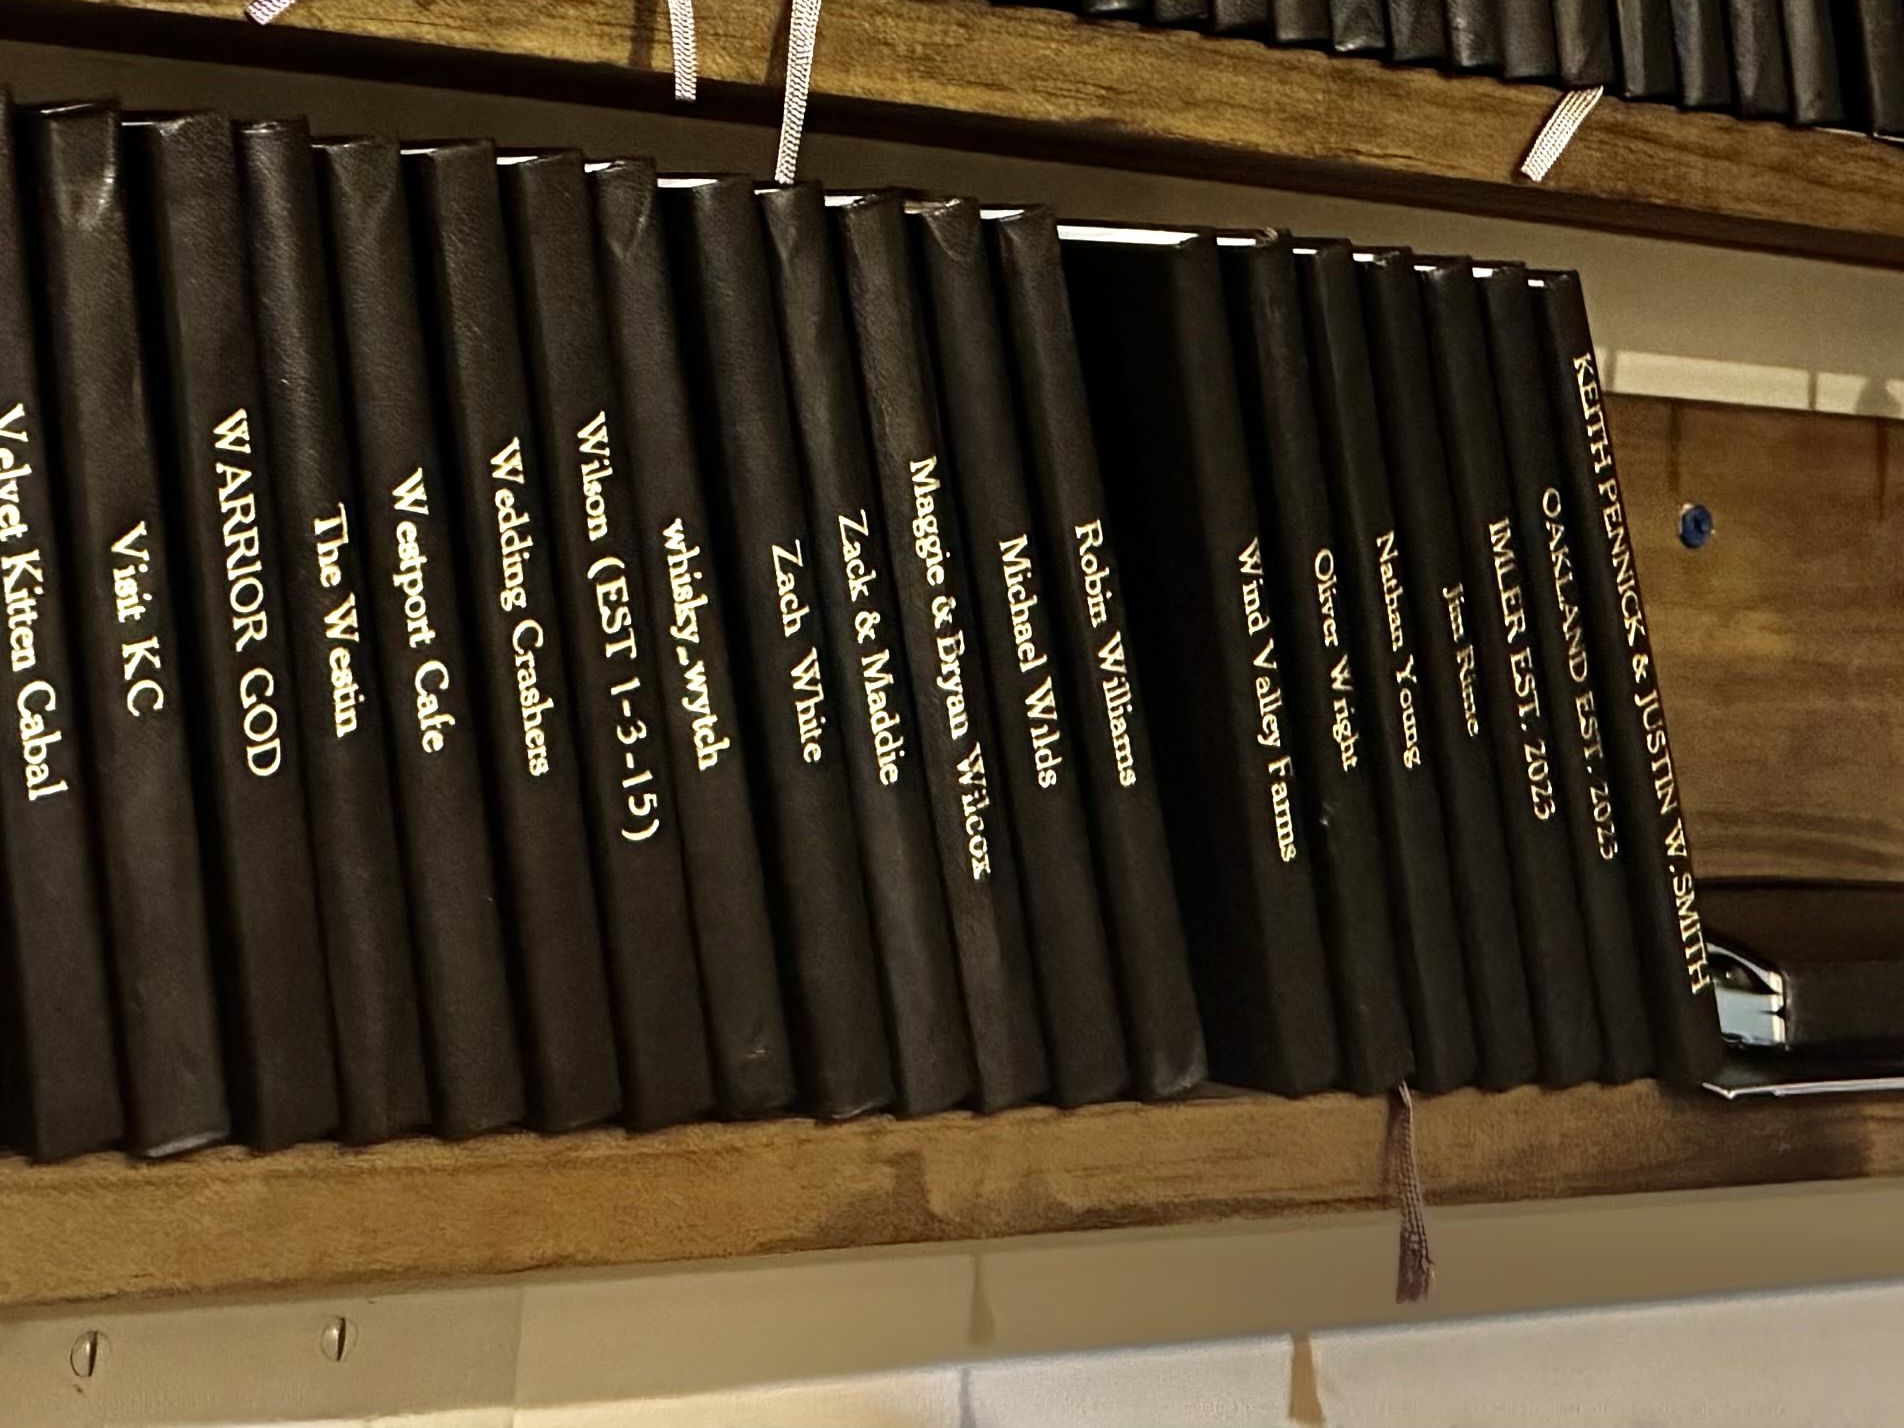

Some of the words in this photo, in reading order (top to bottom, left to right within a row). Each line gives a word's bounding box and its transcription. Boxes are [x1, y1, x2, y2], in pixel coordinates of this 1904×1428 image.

[1572, 351, 1612, 474] KEITH
[212, 407, 268, 653] WARRIOR
[489, 435, 534, 612] Wedding
[576, 409, 614, 542] Wilson
[0, 548, 44, 672] Kitten
[110, 520, 150, 623] Visit
[586, 555, 637, 659] (EST
[770, 538, 810, 637] Zach
[1237, 536, 1270, 636] Wind
[1487, 517, 1526, 644] IMLER
[1597, 478, 1646, 647] PENNICK
[120, 635, 164, 717] KC
[511, 618, 554, 776] Crashers
[789, 646, 824, 763] White
[998, 533, 1048, 673] Michael
[1024, 675, 1063, 789] Wilds
[1073, 518, 1113, 628] Robin
[1096, 630, 1137, 787] Williams
[1252, 637, 1282, 747] Valley
[1313, 548, 1339, 647] Oliver
[1329, 654, 1359, 772] Wright
[1509, 646, 1540, 731] EST.
[1631, 653, 1649, 683] &
[16, 679, 69, 801] Cabal
[238, 666, 281, 776] GOD
[609, 676, 660, 841] 1-3-15)
[1523, 740, 1553, 820] 2023
[1633, 689, 1677, 814] JUSTIN
[1267, 755, 1297, 862] Farms
